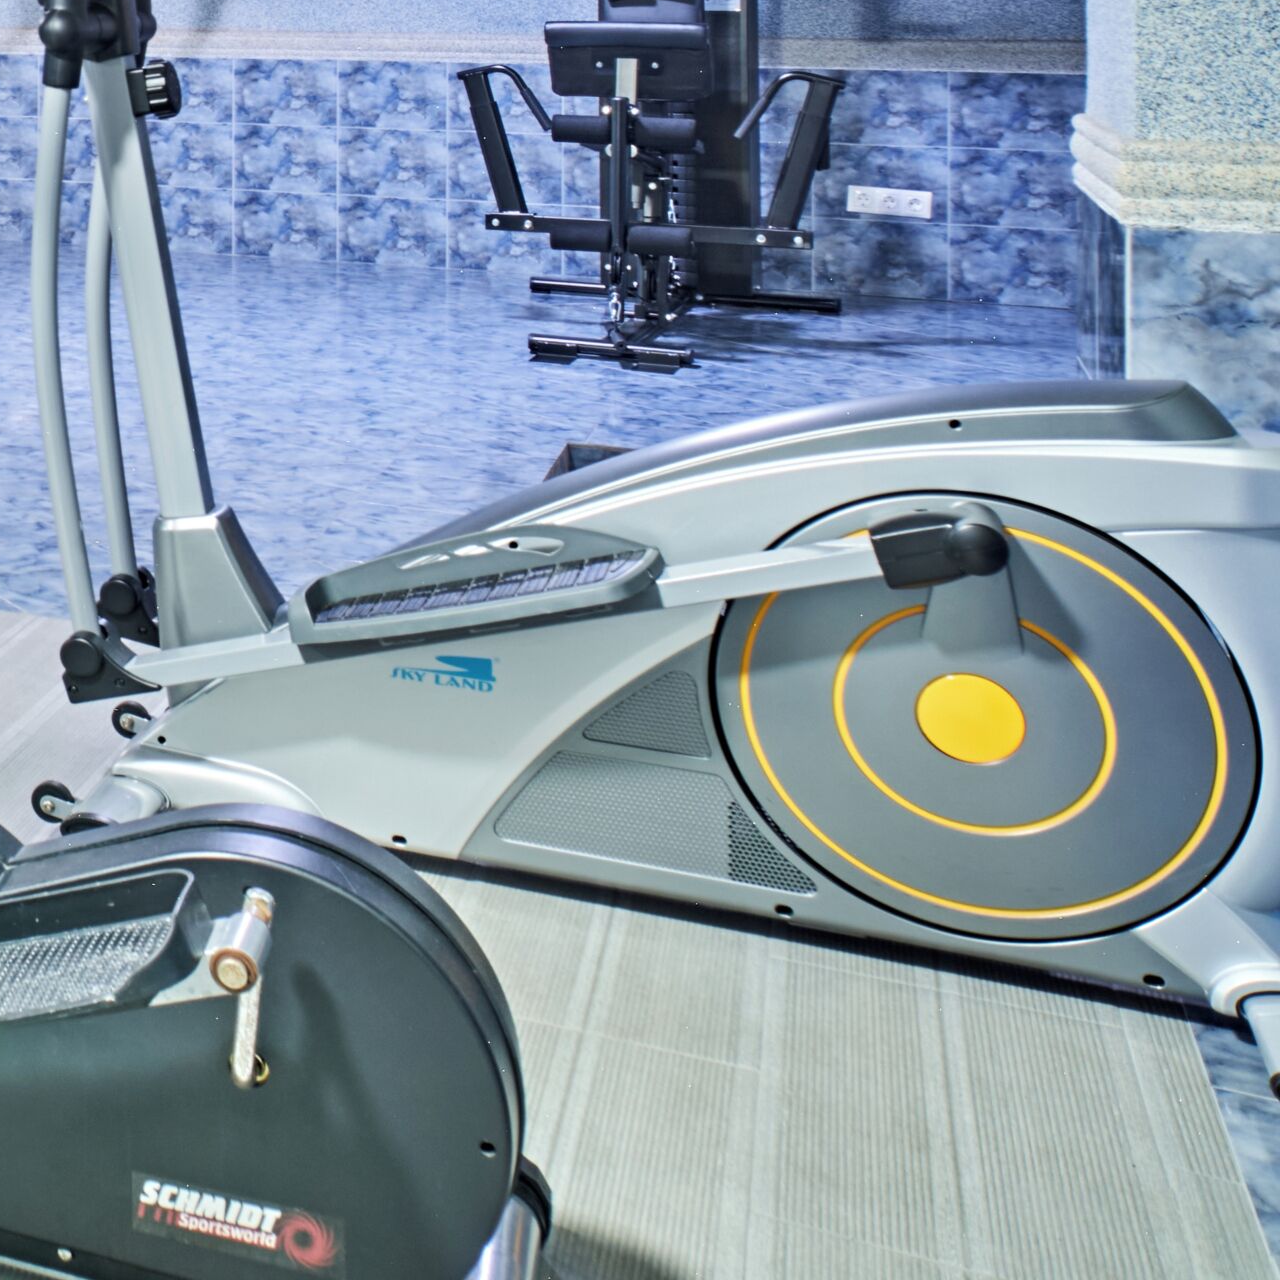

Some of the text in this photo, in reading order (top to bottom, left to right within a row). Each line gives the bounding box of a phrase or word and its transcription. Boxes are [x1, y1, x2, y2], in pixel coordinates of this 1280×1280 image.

[391, 667, 494, 692] SKY LAND
[140, 1179, 282, 1233] SCHMIDT
[178, 1212, 278, 1250] Sportsworld
